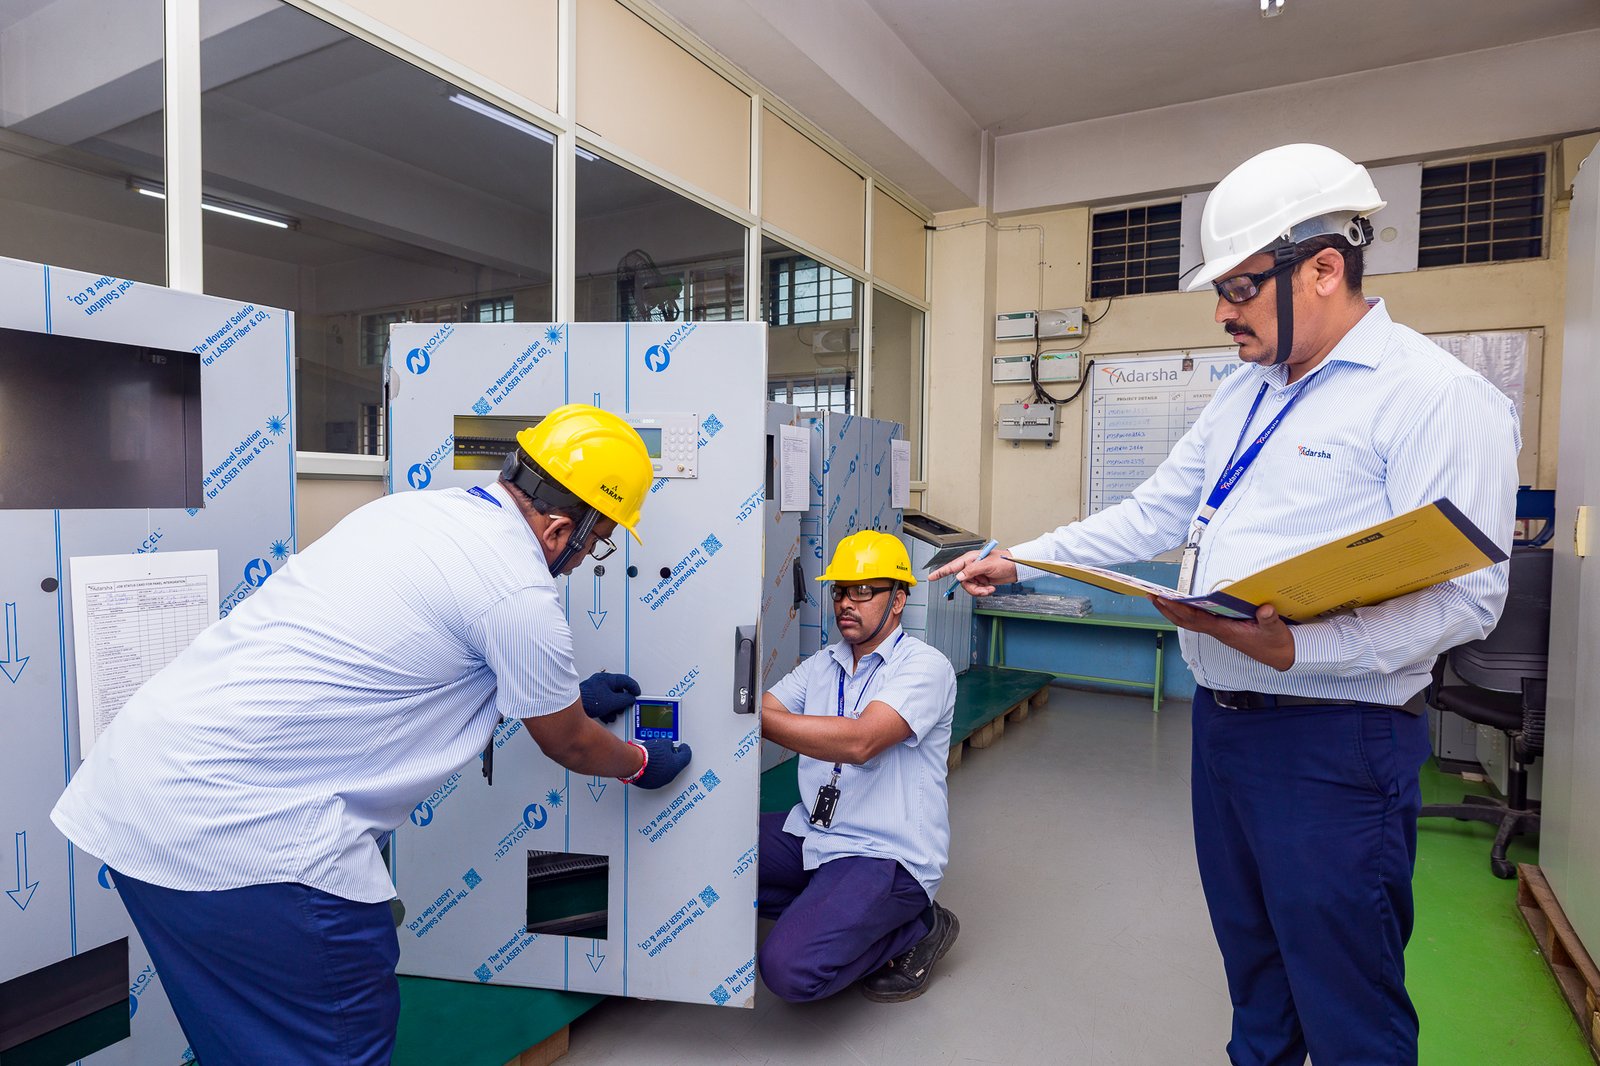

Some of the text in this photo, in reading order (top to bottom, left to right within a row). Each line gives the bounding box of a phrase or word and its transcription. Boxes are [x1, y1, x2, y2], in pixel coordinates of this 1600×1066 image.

[84, 290, 120, 316] Solution
[86, 287, 96, 296] &
[192, 304, 254, 354] The Novacel Solutio
[424, 324, 451, 351] NOVAC
[202, 355, 214, 366] for
[212, 336, 236, 358] LASER
[233, 324, 251, 340] Fiber
[486, 340, 540, 396] The Novacel Solution
[1109, 367, 1178, 384] Adarsha
[493, 395, 504, 405] for
[501, 376, 521, 396] LASER
[519, 362, 534, 378] Fiber
[698, 438, 708, 449] Th
[1259, 420, 1279, 443] Adarsha
[210, 451, 237, 478] Novacel
[234, 430, 262, 455] Solution
[425, 434, 454, 467] NOVACE
[1299, 447, 1331, 459] Adarsha
[206, 488, 219, 499] for
[216, 467, 240, 490] LASER
[237, 453, 255, 470] Fiber
[1222, 466, 1244, 489] Adarsha
[600, 484, 624, 503] KARAM
[132, 532, 163, 554] ACEL
[690, 548, 700, 558] for
[672, 556, 692, 577] LASER
[650, 557, 708, 611] The Novacel Solution
[220, 584, 252, 620] NOVAC
[666, 669, 699, 697] OVACEL
[495, 721, 523, 748] for LASER
[427, 772, 462, 805] NOVACEL
[688, 782, 698, 793] for
[669, 790, 690, 810] LASER
[649, 792, 706, 843] The Novacel Solution
[656, 808, 672, 822] Fiber
[494, 826, 529, 858] NOVACEL
[434, 888, 454, 906] LASER
[687, 898, 697, 908] for
[416, 889, 469, 938] The Novacel Solution
[422, 904, 436, 918] Fiber
[668, 906, 689, 925] LASER
[648, 907, 705, 957] The Novacel Solution
[655, 922, 671, 937] Fiber
[488, 953, 500, 964] The
[498, 933, 520, 955] Novacel
[494, 935, 535, 972] for LASER Fiber
[724, 974, 738, 985] The
[732, 984, 742, 994] for
